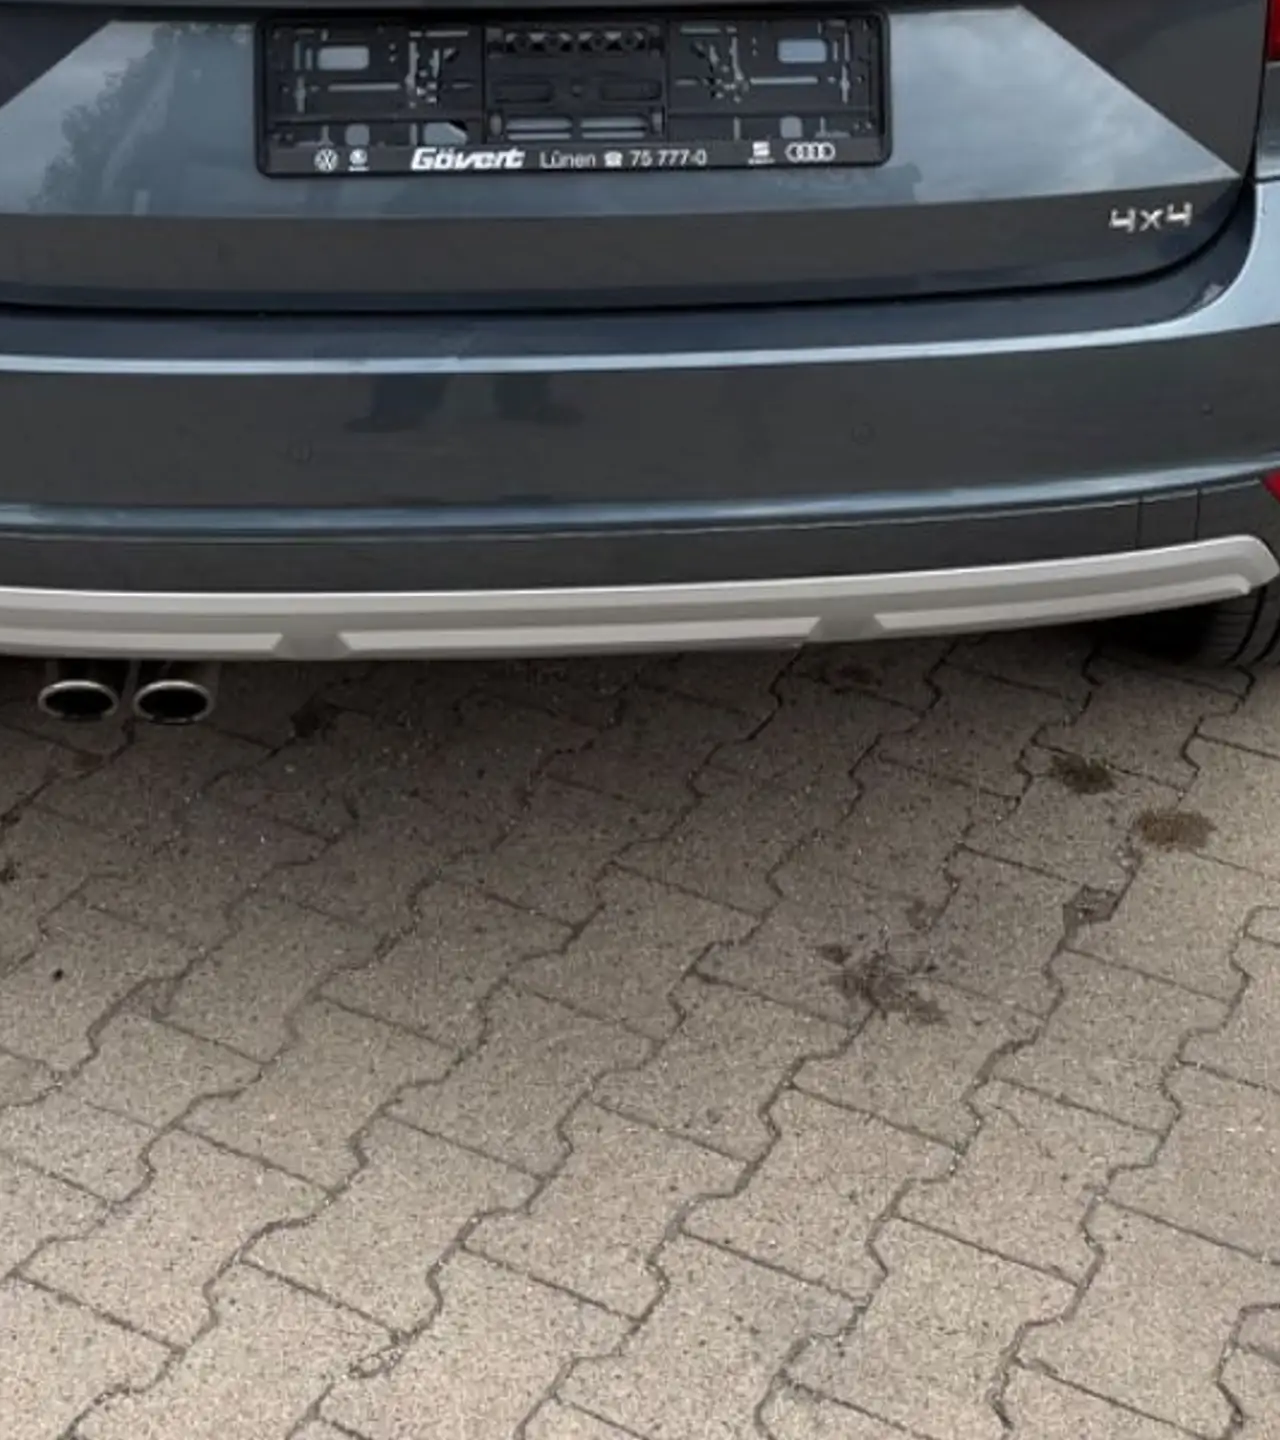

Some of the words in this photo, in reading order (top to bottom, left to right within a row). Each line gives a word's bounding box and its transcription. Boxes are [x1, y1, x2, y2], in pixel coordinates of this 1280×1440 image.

[410, 146, 525, 171] Gövert
[539, 149, 596, 168] Lünen
[1109, 201, 1193, 233] 4x4
